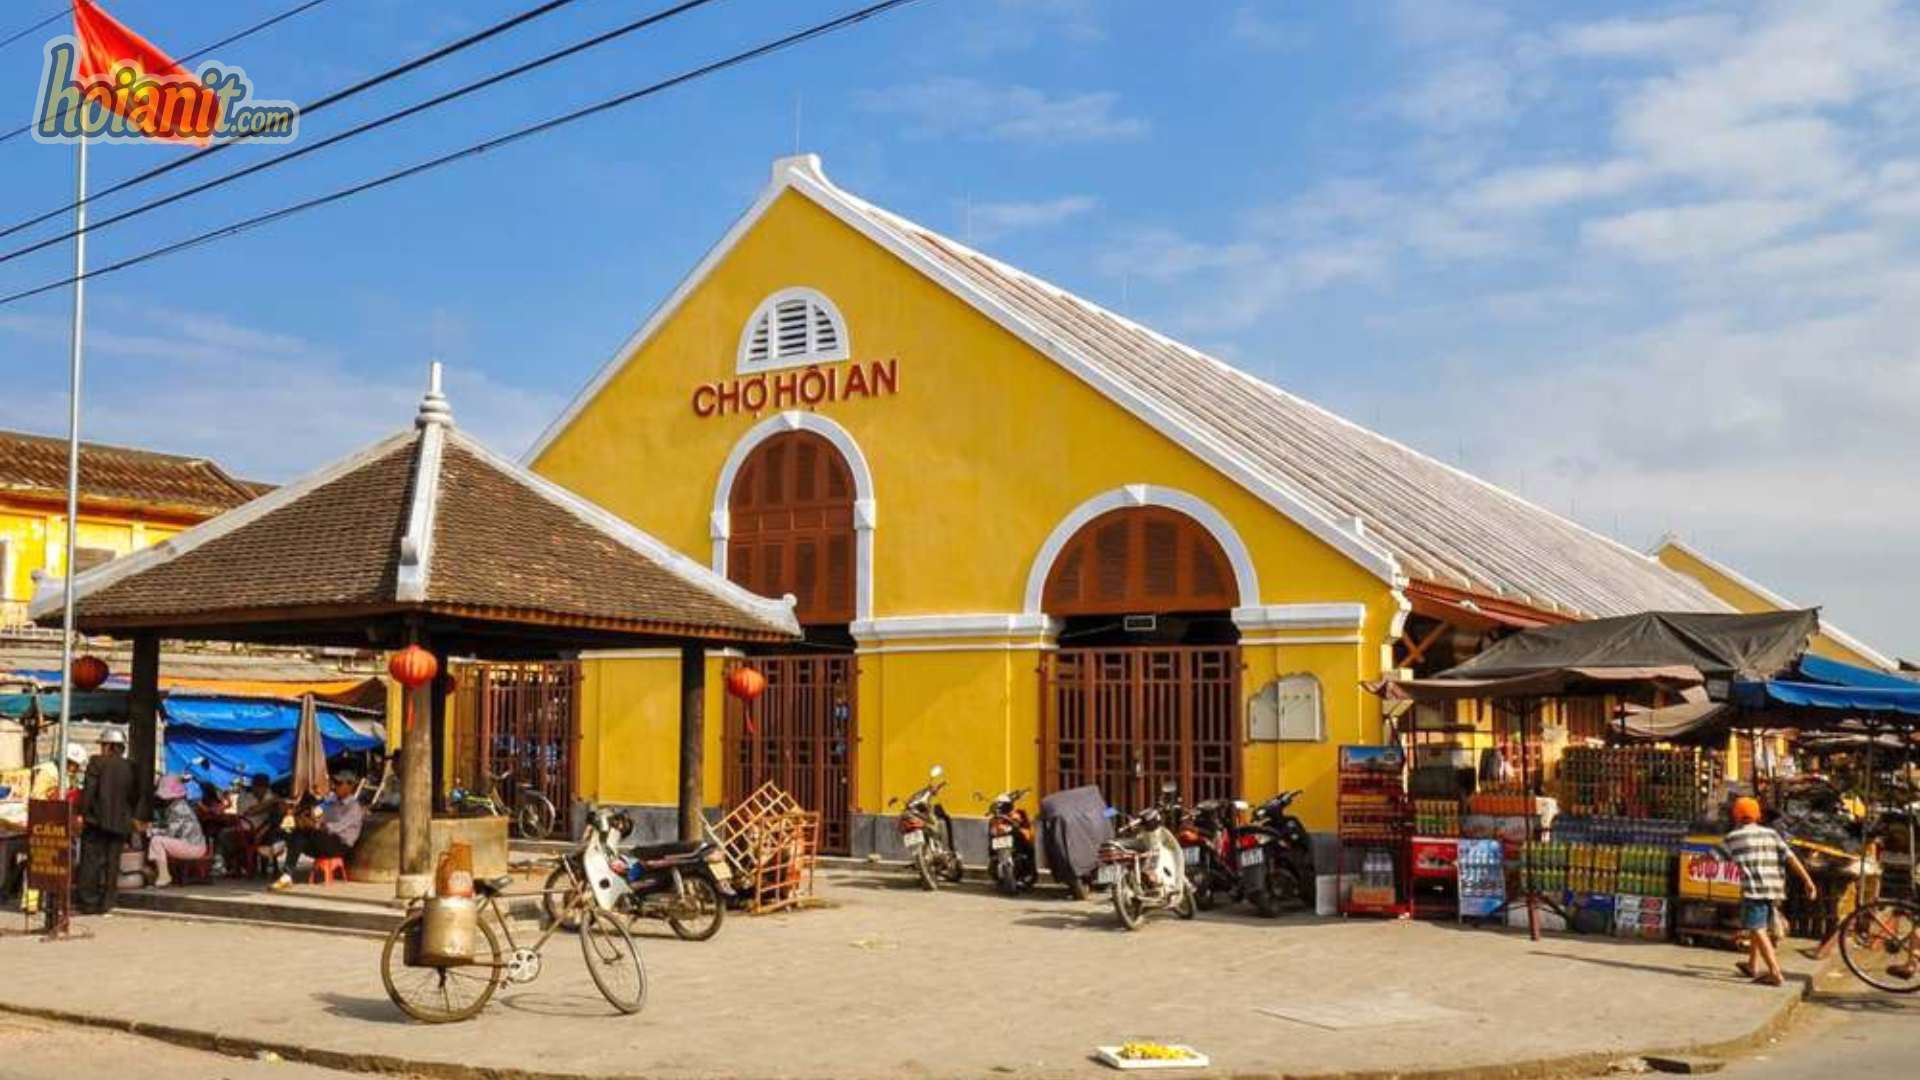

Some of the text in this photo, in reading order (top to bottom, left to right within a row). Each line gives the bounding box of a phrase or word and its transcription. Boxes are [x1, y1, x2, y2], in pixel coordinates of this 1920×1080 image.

[691, 358, 898, 419] CHỢ HỘI AN
